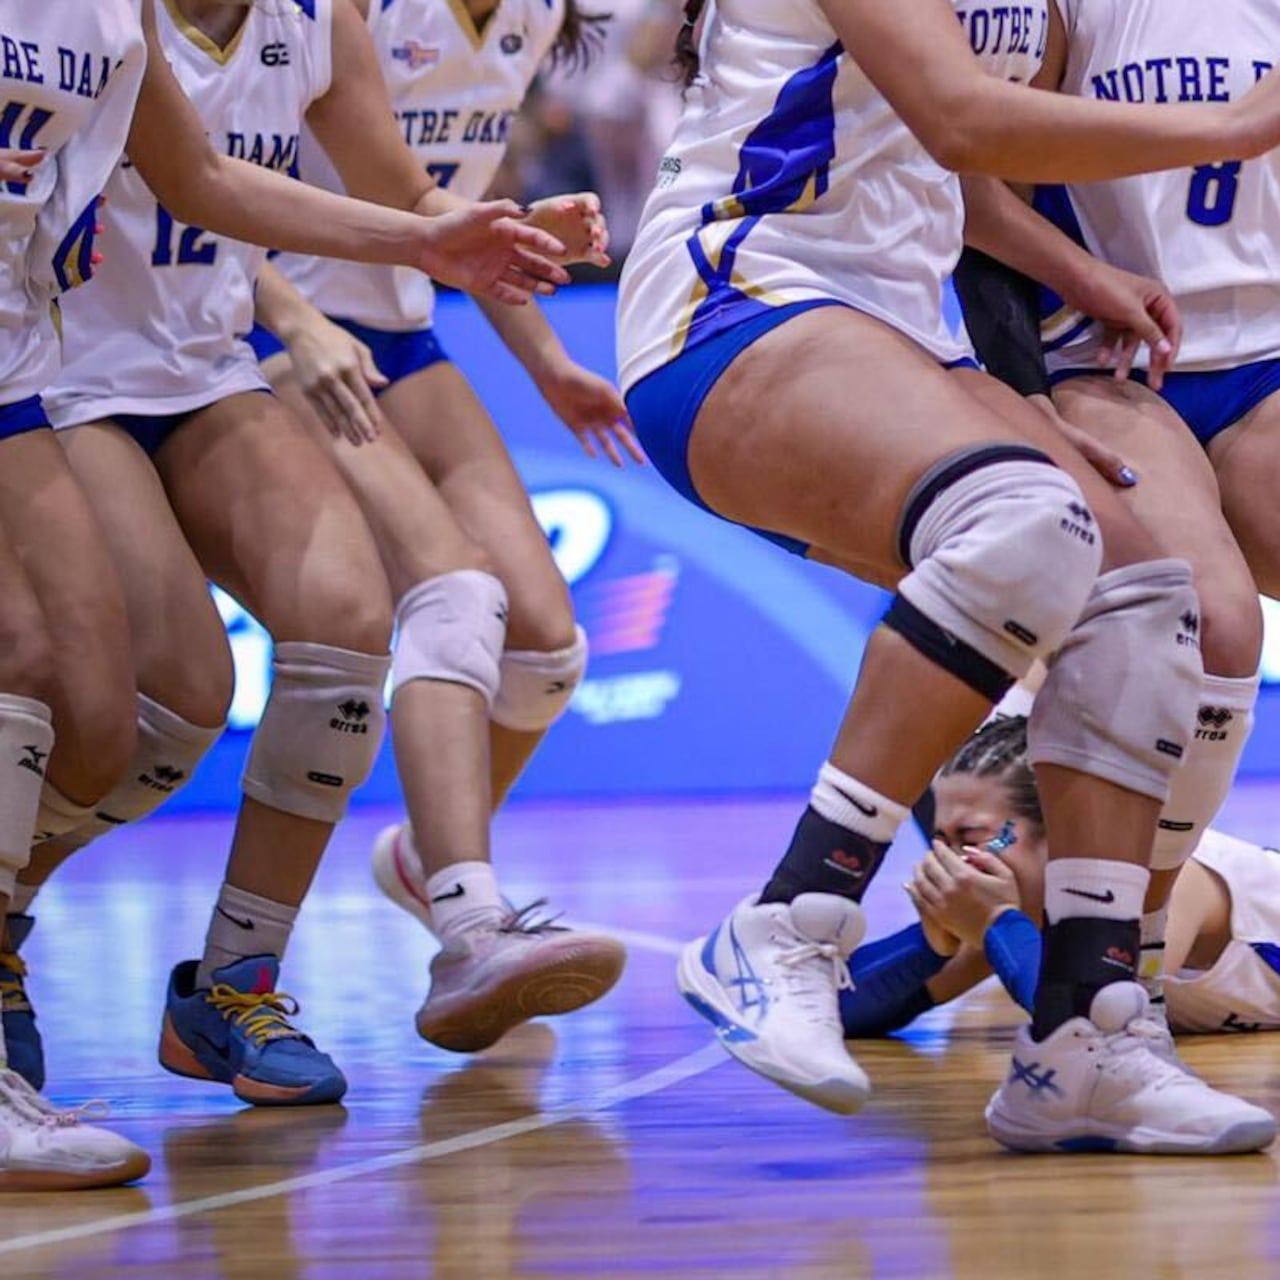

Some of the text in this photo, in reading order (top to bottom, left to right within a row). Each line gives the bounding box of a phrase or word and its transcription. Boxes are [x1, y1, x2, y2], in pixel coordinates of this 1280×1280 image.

[956, 6, 1033, 56] OTRE
[1091, 56, 1230, 105] NOTRE
[394, 109, 458, 147] TRE
[1194, 727, 1228, 742] rrea
